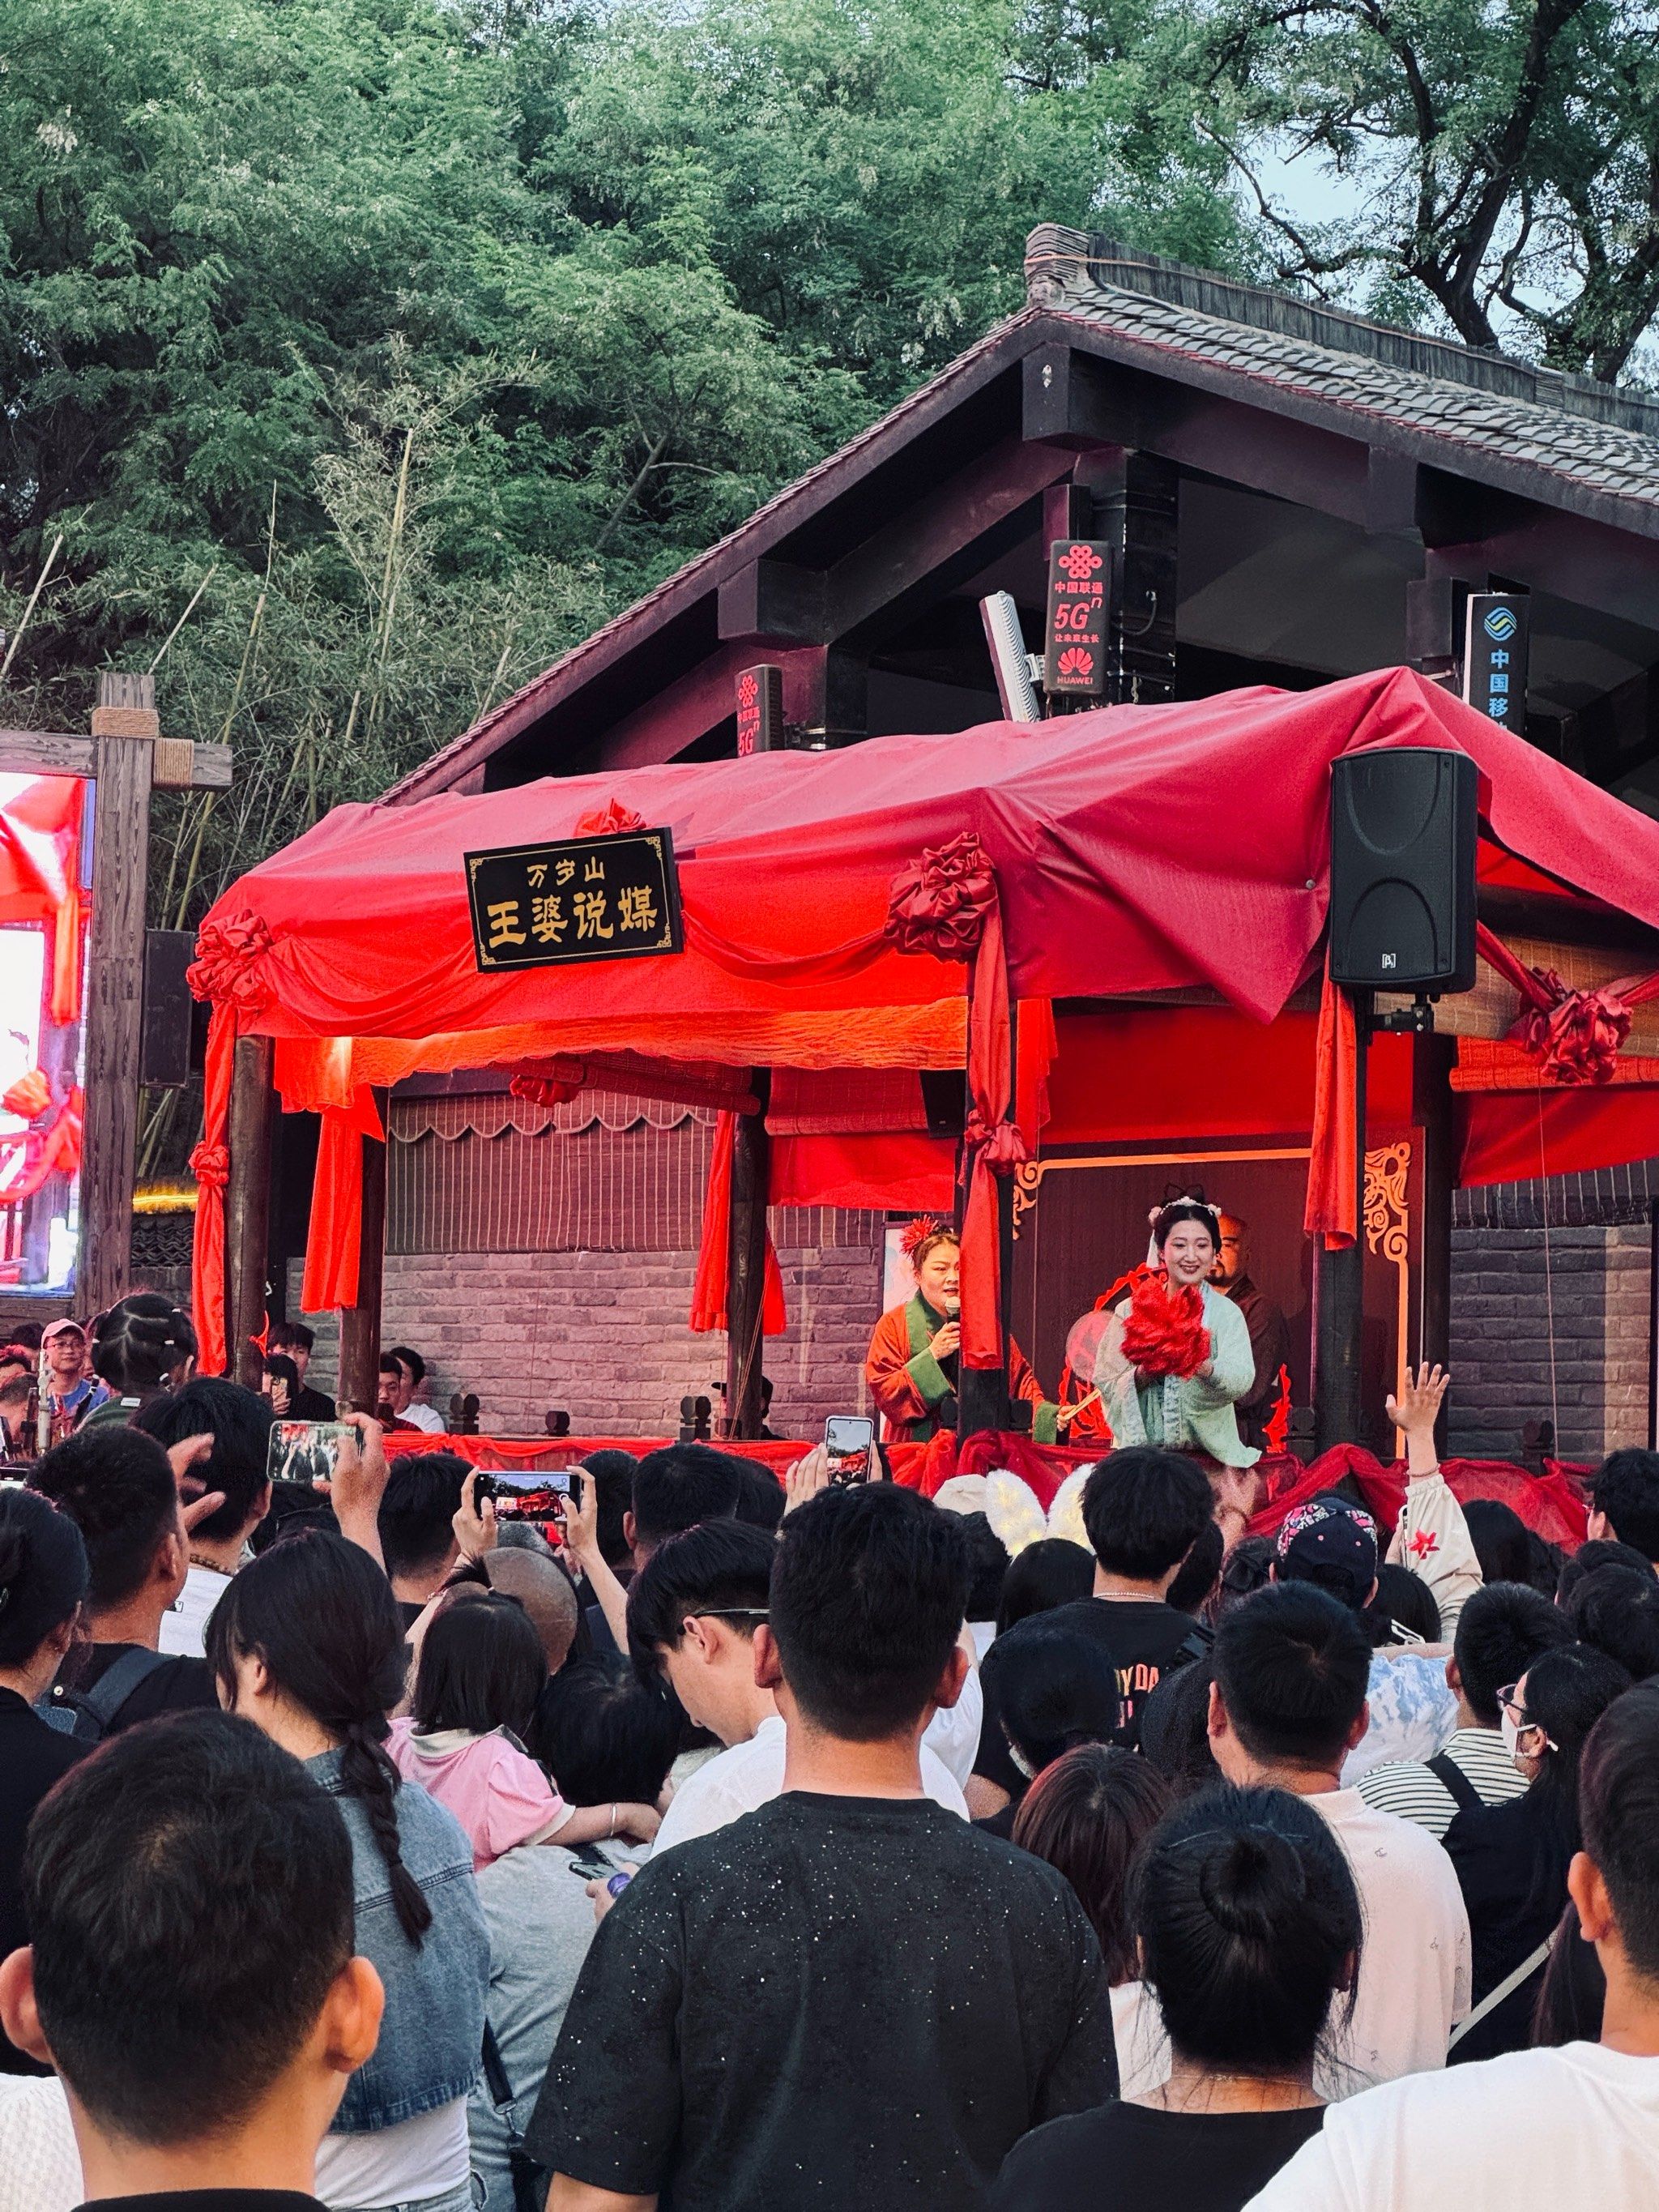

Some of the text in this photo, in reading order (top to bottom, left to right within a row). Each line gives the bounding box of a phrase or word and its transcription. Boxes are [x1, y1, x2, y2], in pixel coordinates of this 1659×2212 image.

[1055, 581, 1103, 594] 中国联通
[1056, 676, 1094, 685] HUAWEI
[527, 856, 605, 888] 万岁山
[487, 885, 658, 949] 王婆说媒
